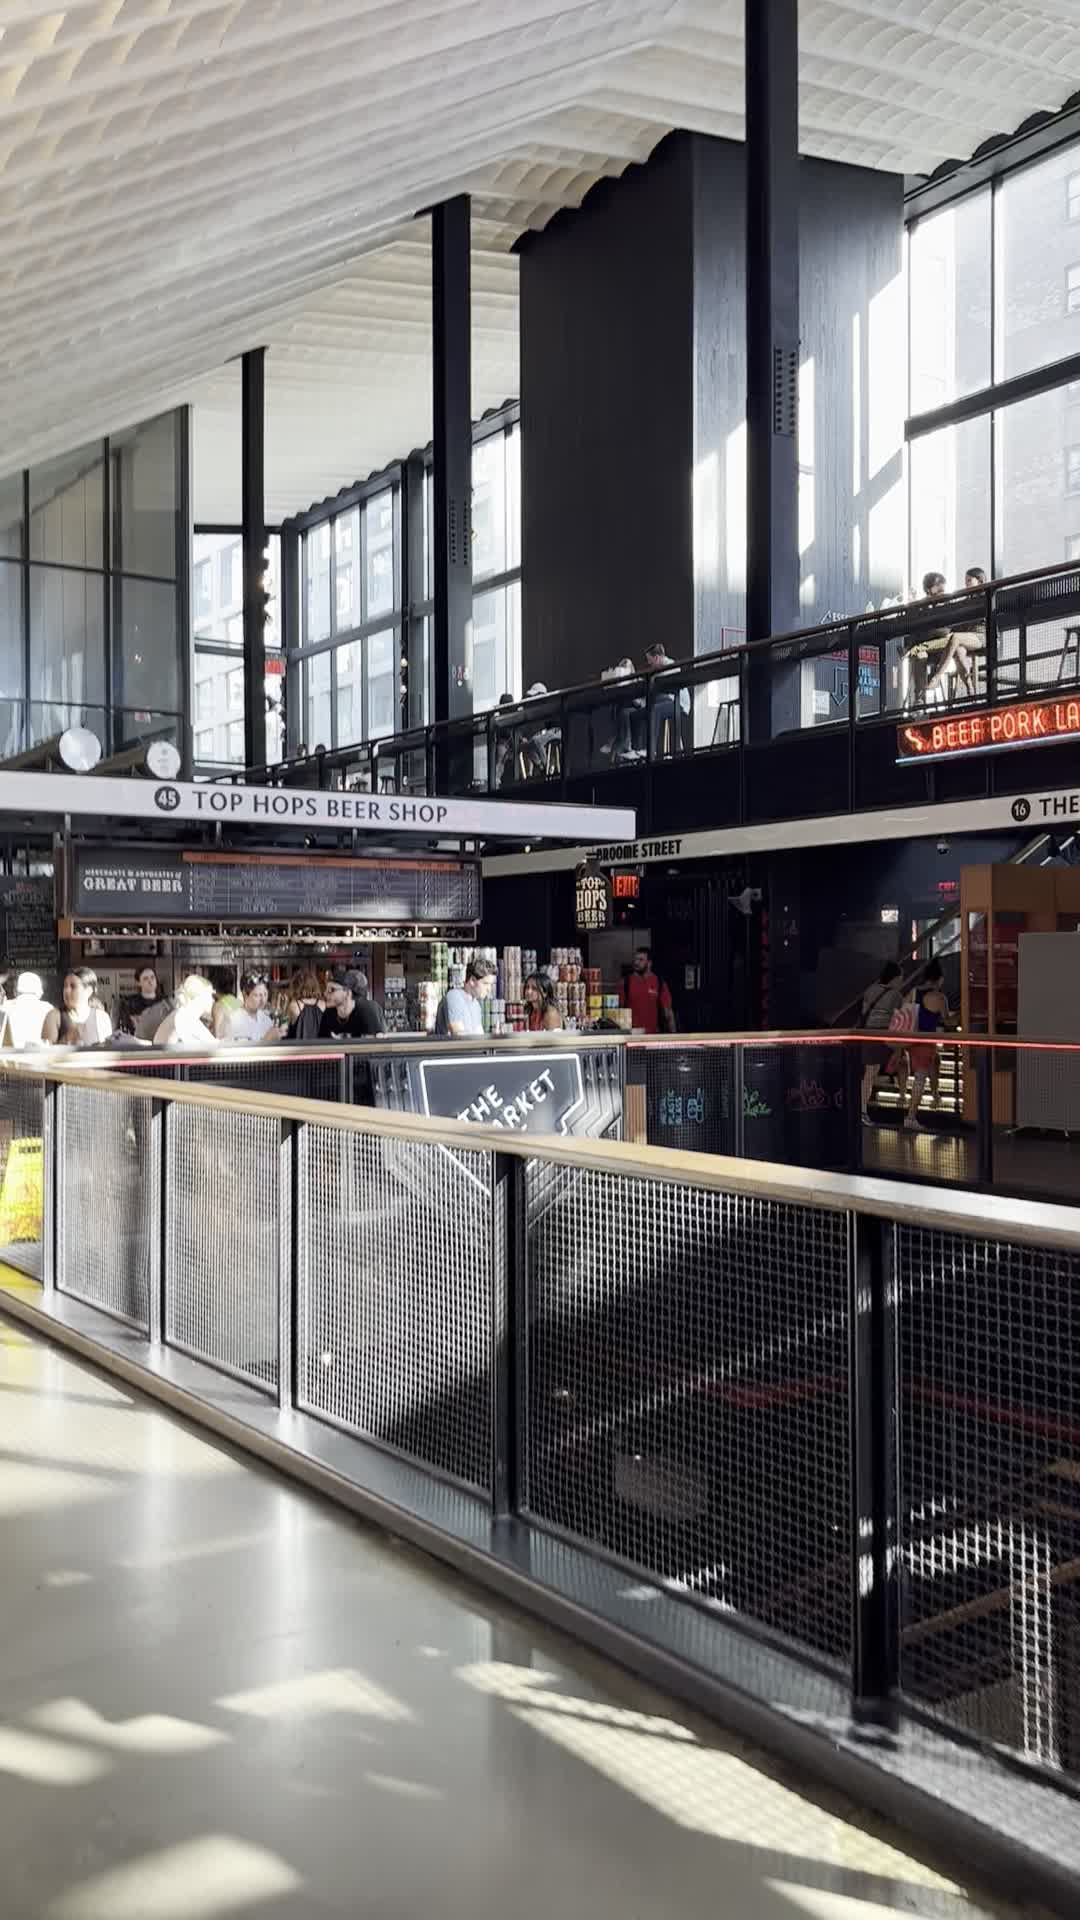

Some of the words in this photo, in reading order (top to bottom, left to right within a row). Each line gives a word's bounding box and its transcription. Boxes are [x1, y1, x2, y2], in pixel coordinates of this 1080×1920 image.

[932, 718, 981, 749] BEEF
[991, 708, 1046, 741] PORK
[159, 789, 178, 808] 45
[192, 790, 243, 812] TOP
[254, 794, 317, 817] HOPS
[327, 799, 380, 820] BEER
[389, 802, 447, 823] SHOP
[1014, 803, 1027, 817] 16
[1039, 795, 1080, 817] THE
[641, 839, 682, 858] STREET
[83, 877, 137, 892] GREAT
[141, 878, 183, 893] BEER
[581, 876, 602, 890] TOP
[615, 876, 638, 897] EXIT
[576, 888, 608, 912] HOPS
[577, 909, 606, 922] BEER
[457, 1084, 504, 1123] THE
